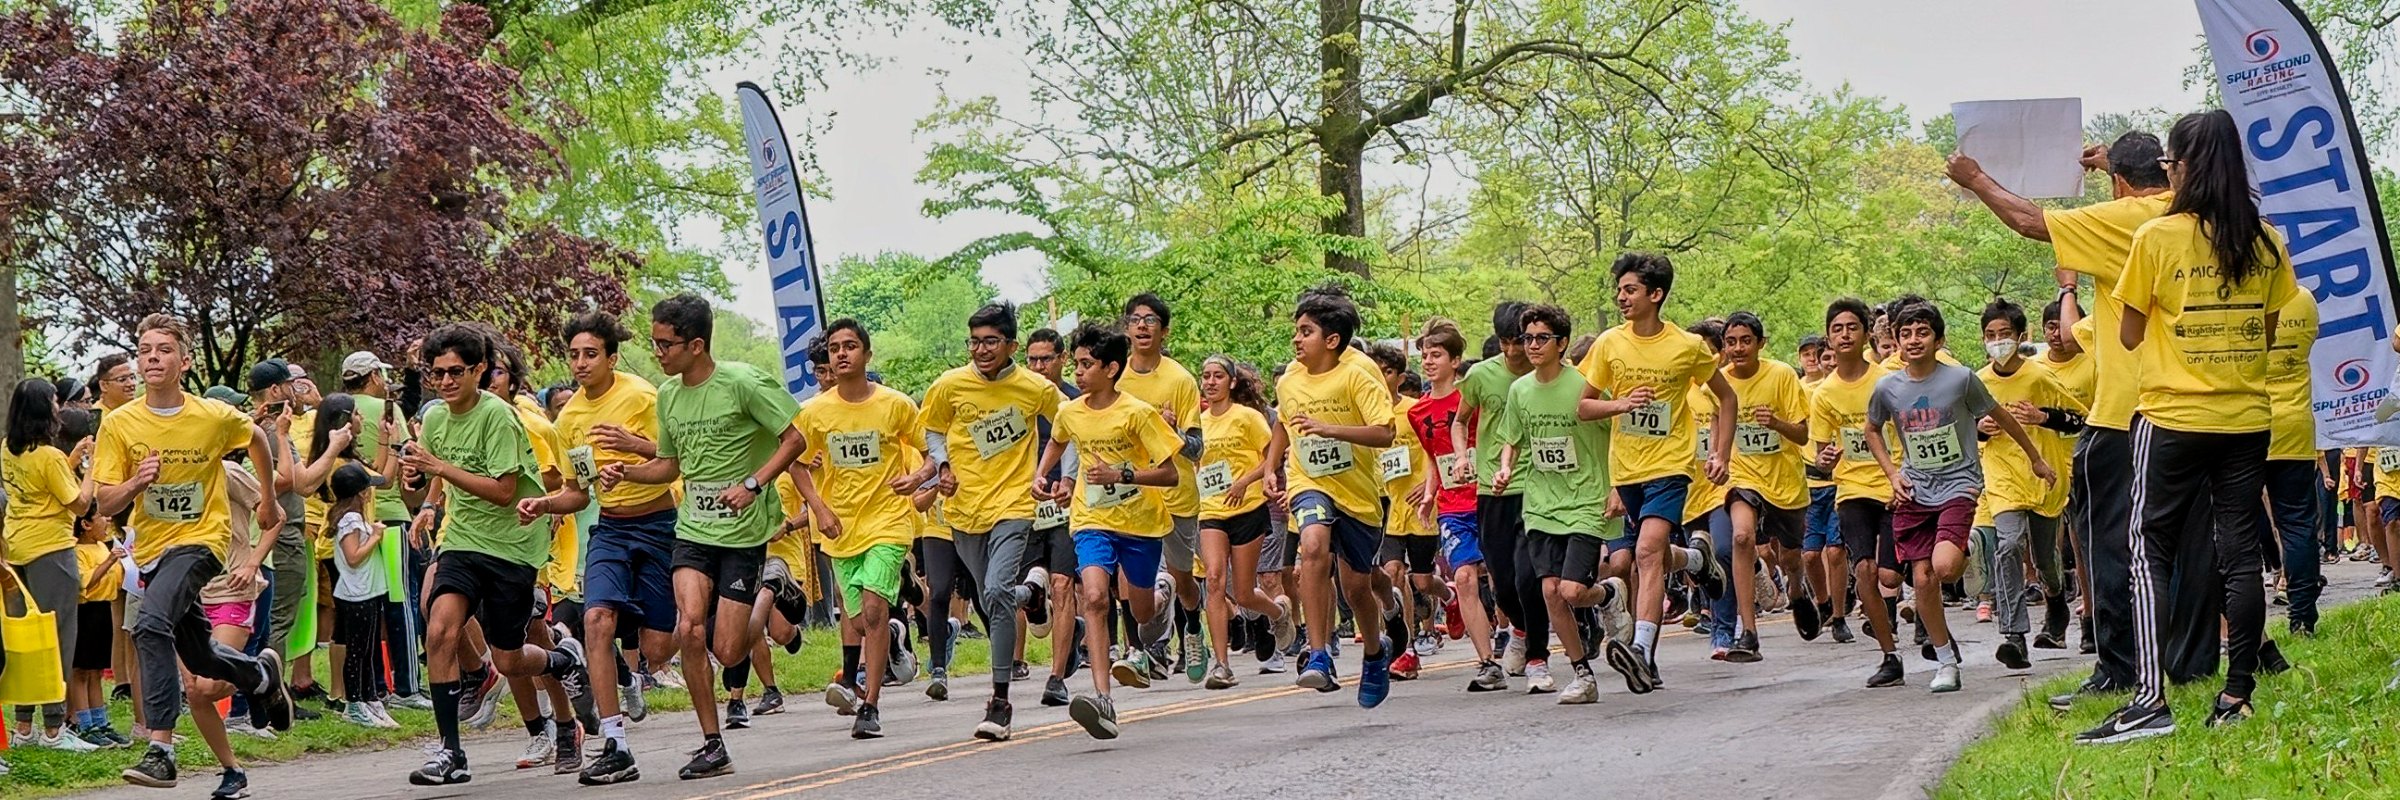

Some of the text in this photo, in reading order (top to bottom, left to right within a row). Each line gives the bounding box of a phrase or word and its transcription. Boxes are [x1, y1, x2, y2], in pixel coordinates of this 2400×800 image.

[2226, 67, 2260, 84] SPLIT
[2263, 53, 2312, 75] SECOND
[2247, 68, 2295, 87] RACING
[2247, 105, 2388, 341] START
[2174, 269, 2186, 282] A
[767, 210, 818, 395] STAR
[2276, 319, 2308, 329] EVENT
[2312, 387, 2390, 413] SPLIT SECON
[1629, 410, 1660, 429] 170
[986, 421, 1015, 444] 421
[1742, 432, 1770, 447] 147
[839, 443, 870, 459] 146
[1308, 446, 1341, 466] 454
[1851, 440, 1870, 454] 34
[1917, 440, 1950, 459] 315
[1537, 449, 1566, 464] 163
[1203, 472, 1225, 489] 332
[155, 496, 192, 513] 142
[1037, 505, 1063, 520] 404
